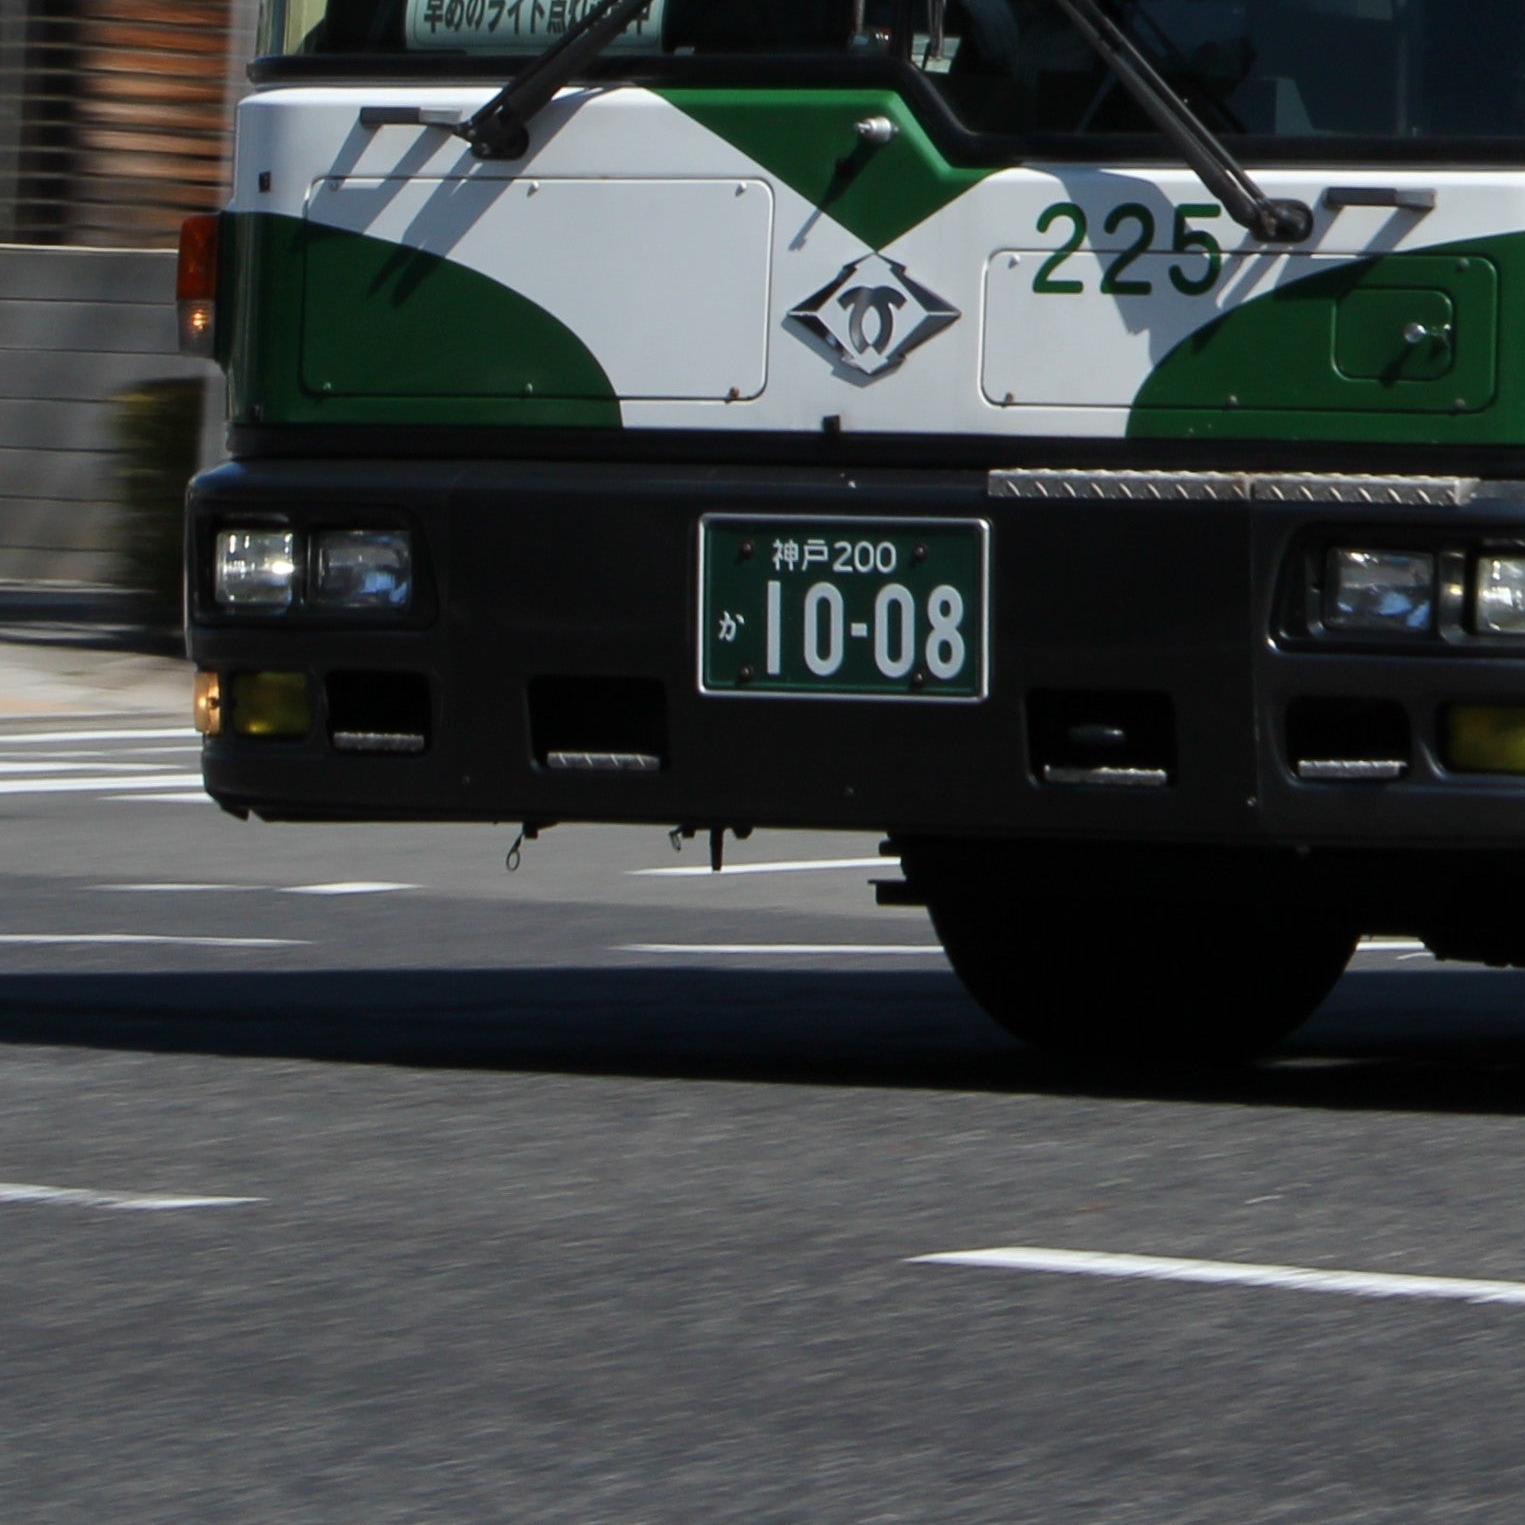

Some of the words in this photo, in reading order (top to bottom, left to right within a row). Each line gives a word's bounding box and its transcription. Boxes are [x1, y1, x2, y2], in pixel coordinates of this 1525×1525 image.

[1031, 201, 1223, 296] 225
[717, 610, 746, 642] か
[766, 579, 967, 680] 10-08
